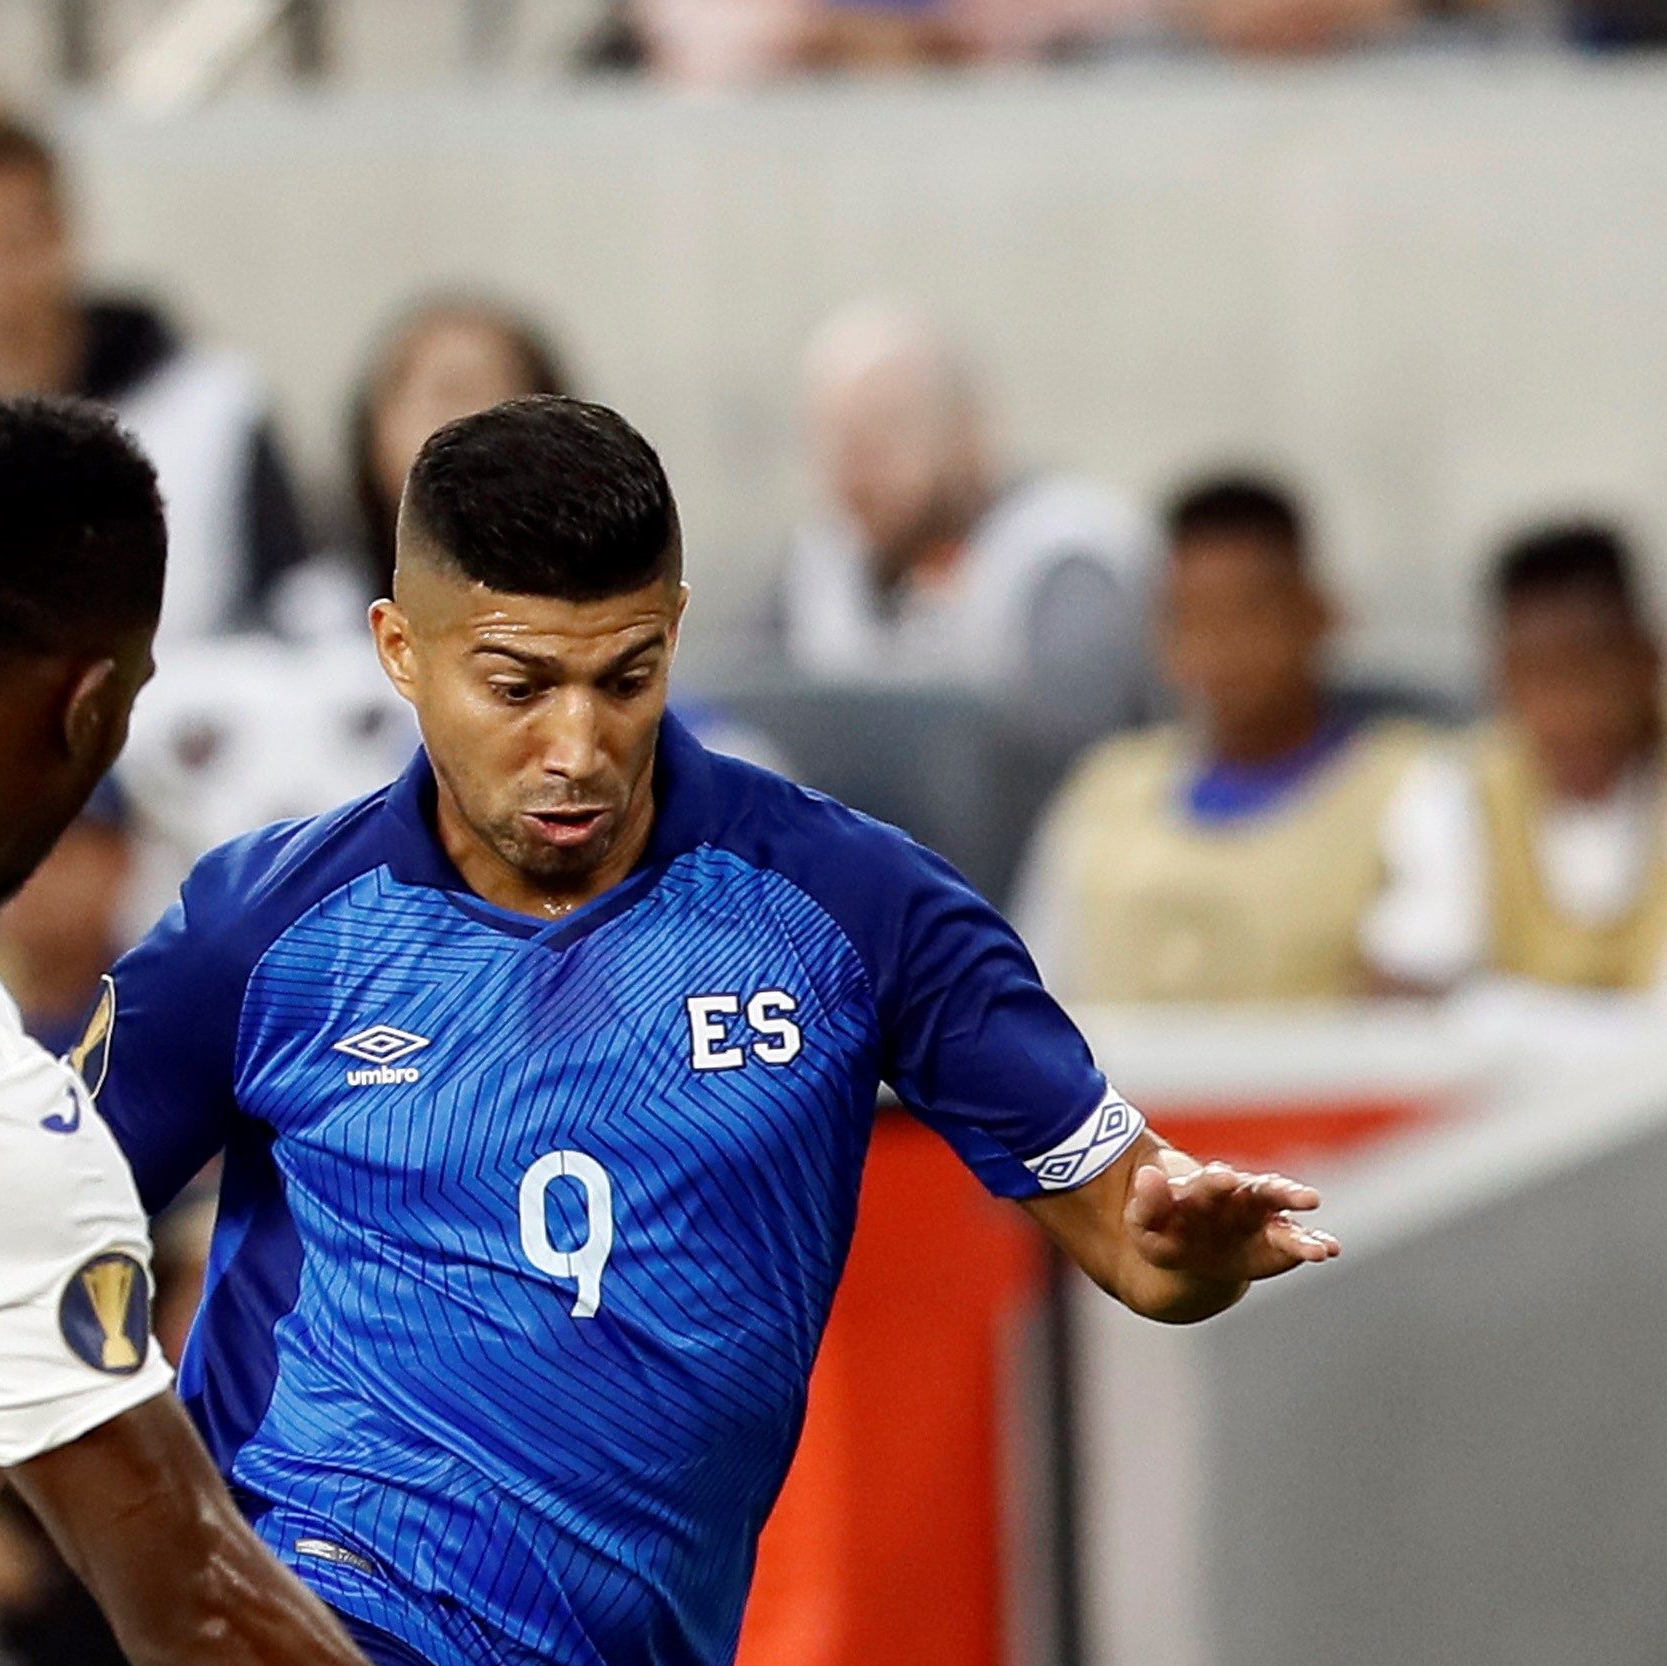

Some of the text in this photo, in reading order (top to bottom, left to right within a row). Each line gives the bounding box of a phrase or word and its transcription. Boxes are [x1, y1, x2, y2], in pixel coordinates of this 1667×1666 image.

[688, 988, 803, 1072] ES
[346, 1064, 420, 1086] umbro
[518, 1149, 615, 1319] 9
